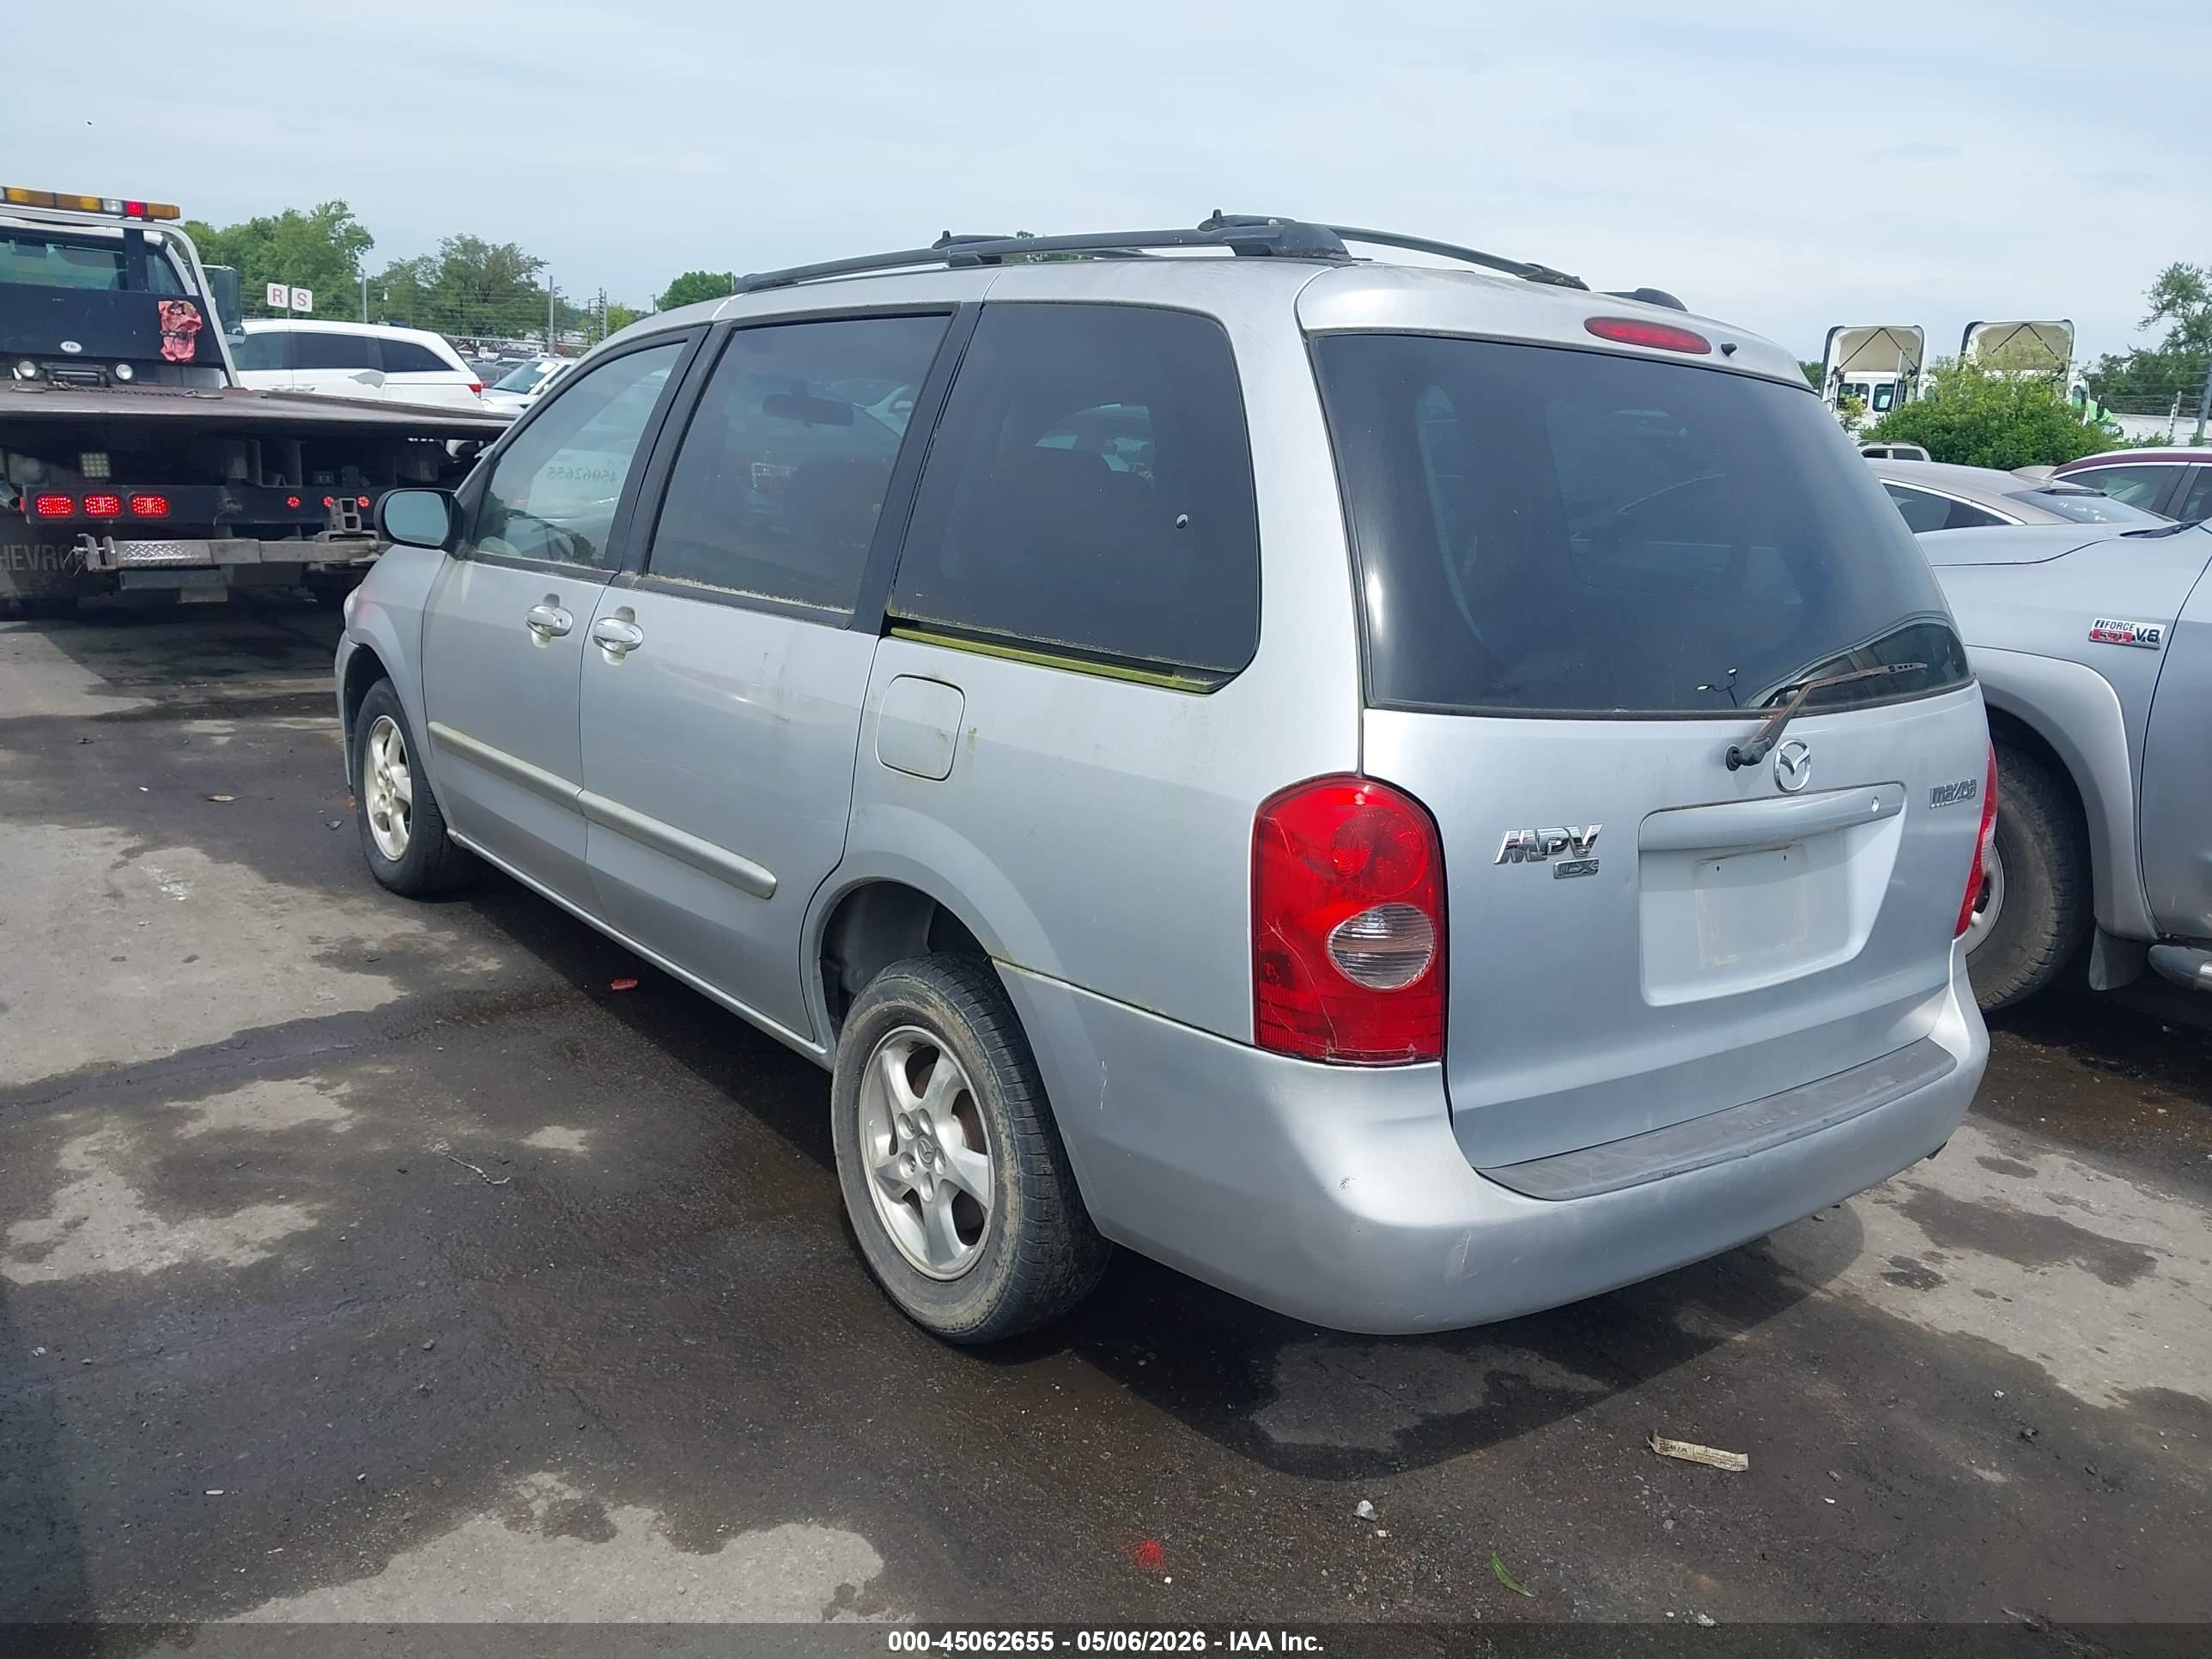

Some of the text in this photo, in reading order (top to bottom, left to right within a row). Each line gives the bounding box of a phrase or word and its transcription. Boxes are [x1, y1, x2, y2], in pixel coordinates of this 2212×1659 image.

[272, 288, 307, 307] R S
[2136, 627, 2160, 643] V8
[1493, 823, 1604, 865] MPV
